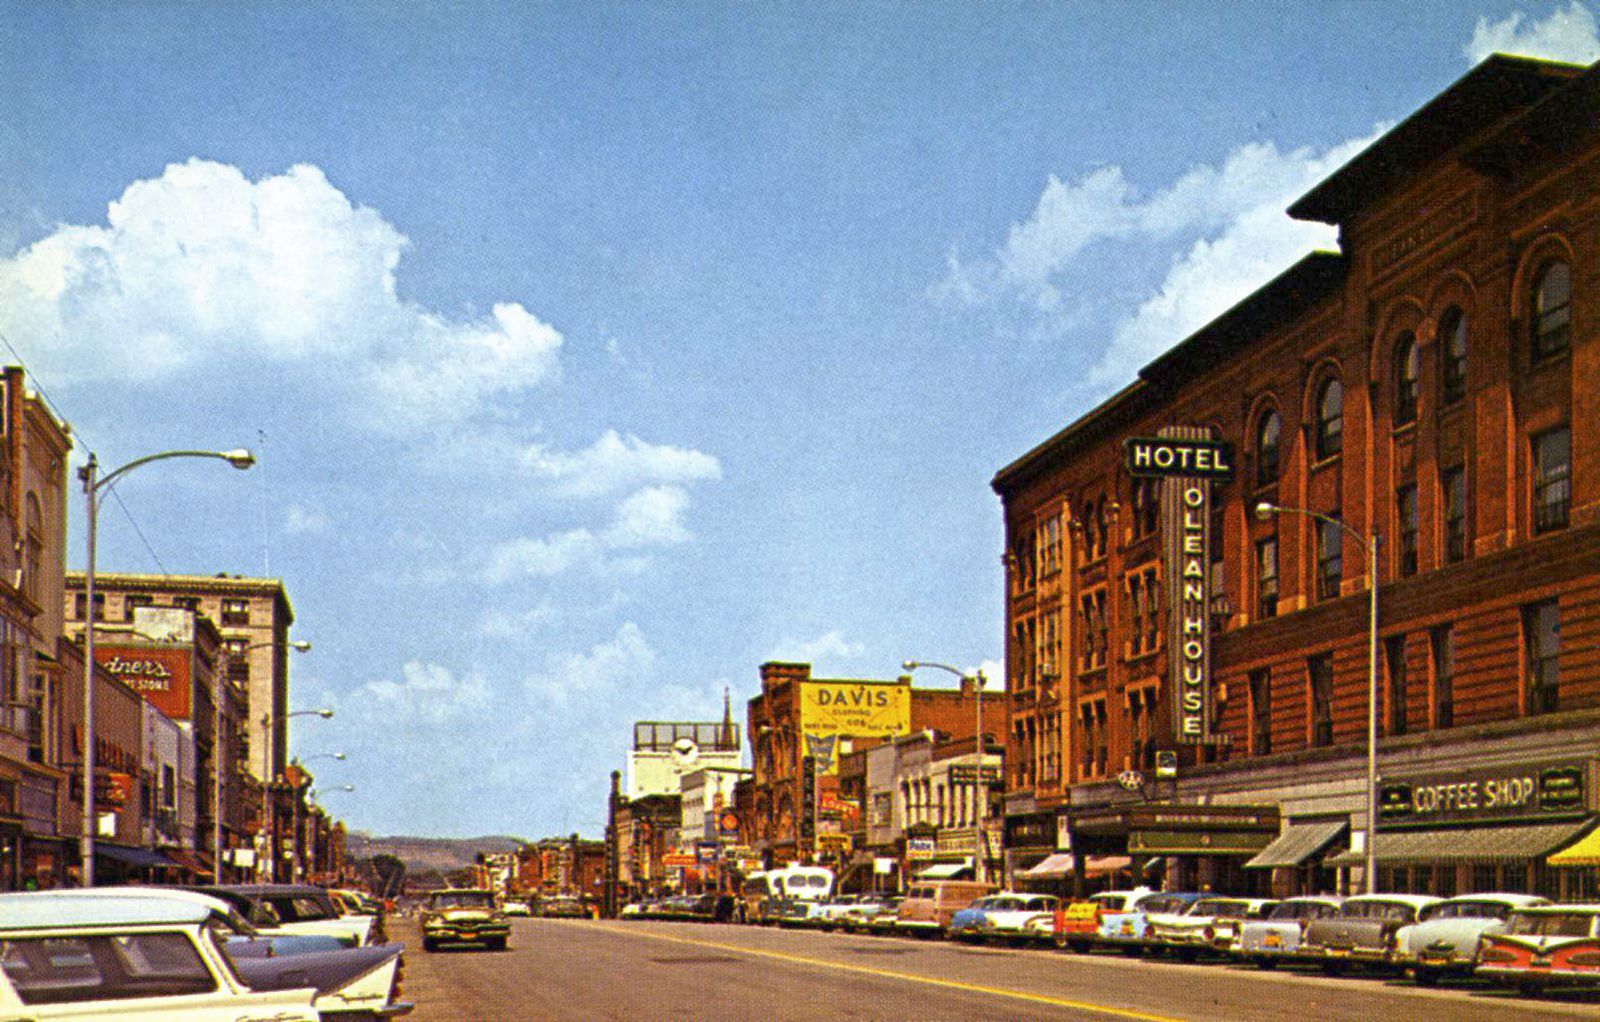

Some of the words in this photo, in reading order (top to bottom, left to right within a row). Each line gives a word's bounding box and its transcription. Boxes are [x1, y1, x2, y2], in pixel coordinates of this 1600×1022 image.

[1134, 445, 1230, 470] HOTEL
[1183, 487, 1204, 601] OLEAN
[1183, 616, 1204, 734] HOUSE
[818, 689, 888, 706] DAVIS
[1414, 783, 1478, 812] COFFEE
[1484, 777, 1534, 807] SHOP
